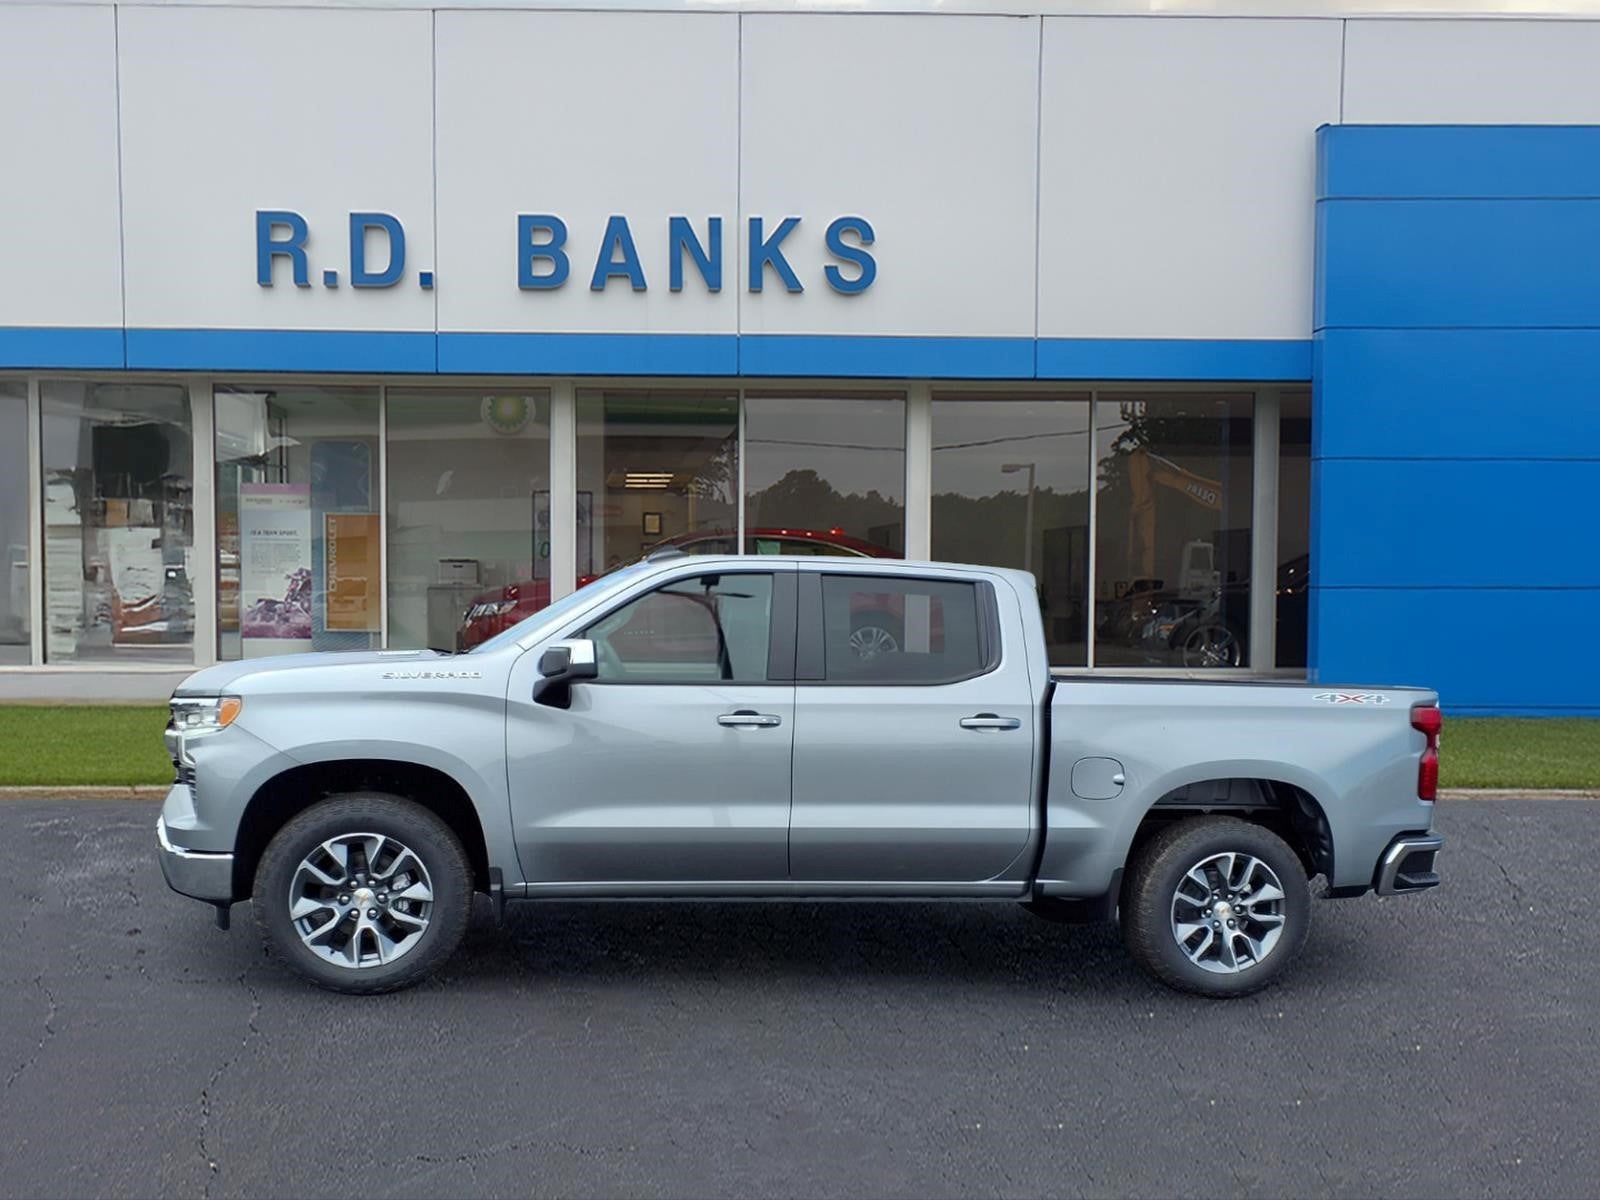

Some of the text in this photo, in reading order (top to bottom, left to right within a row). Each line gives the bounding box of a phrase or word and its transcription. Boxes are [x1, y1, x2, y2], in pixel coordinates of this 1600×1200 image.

[256, 210, 877, 295] R.D. BANKS
[327, 516, 337, 592] CHEVROLET
[381, 671, 483, 680] SILVERADO
